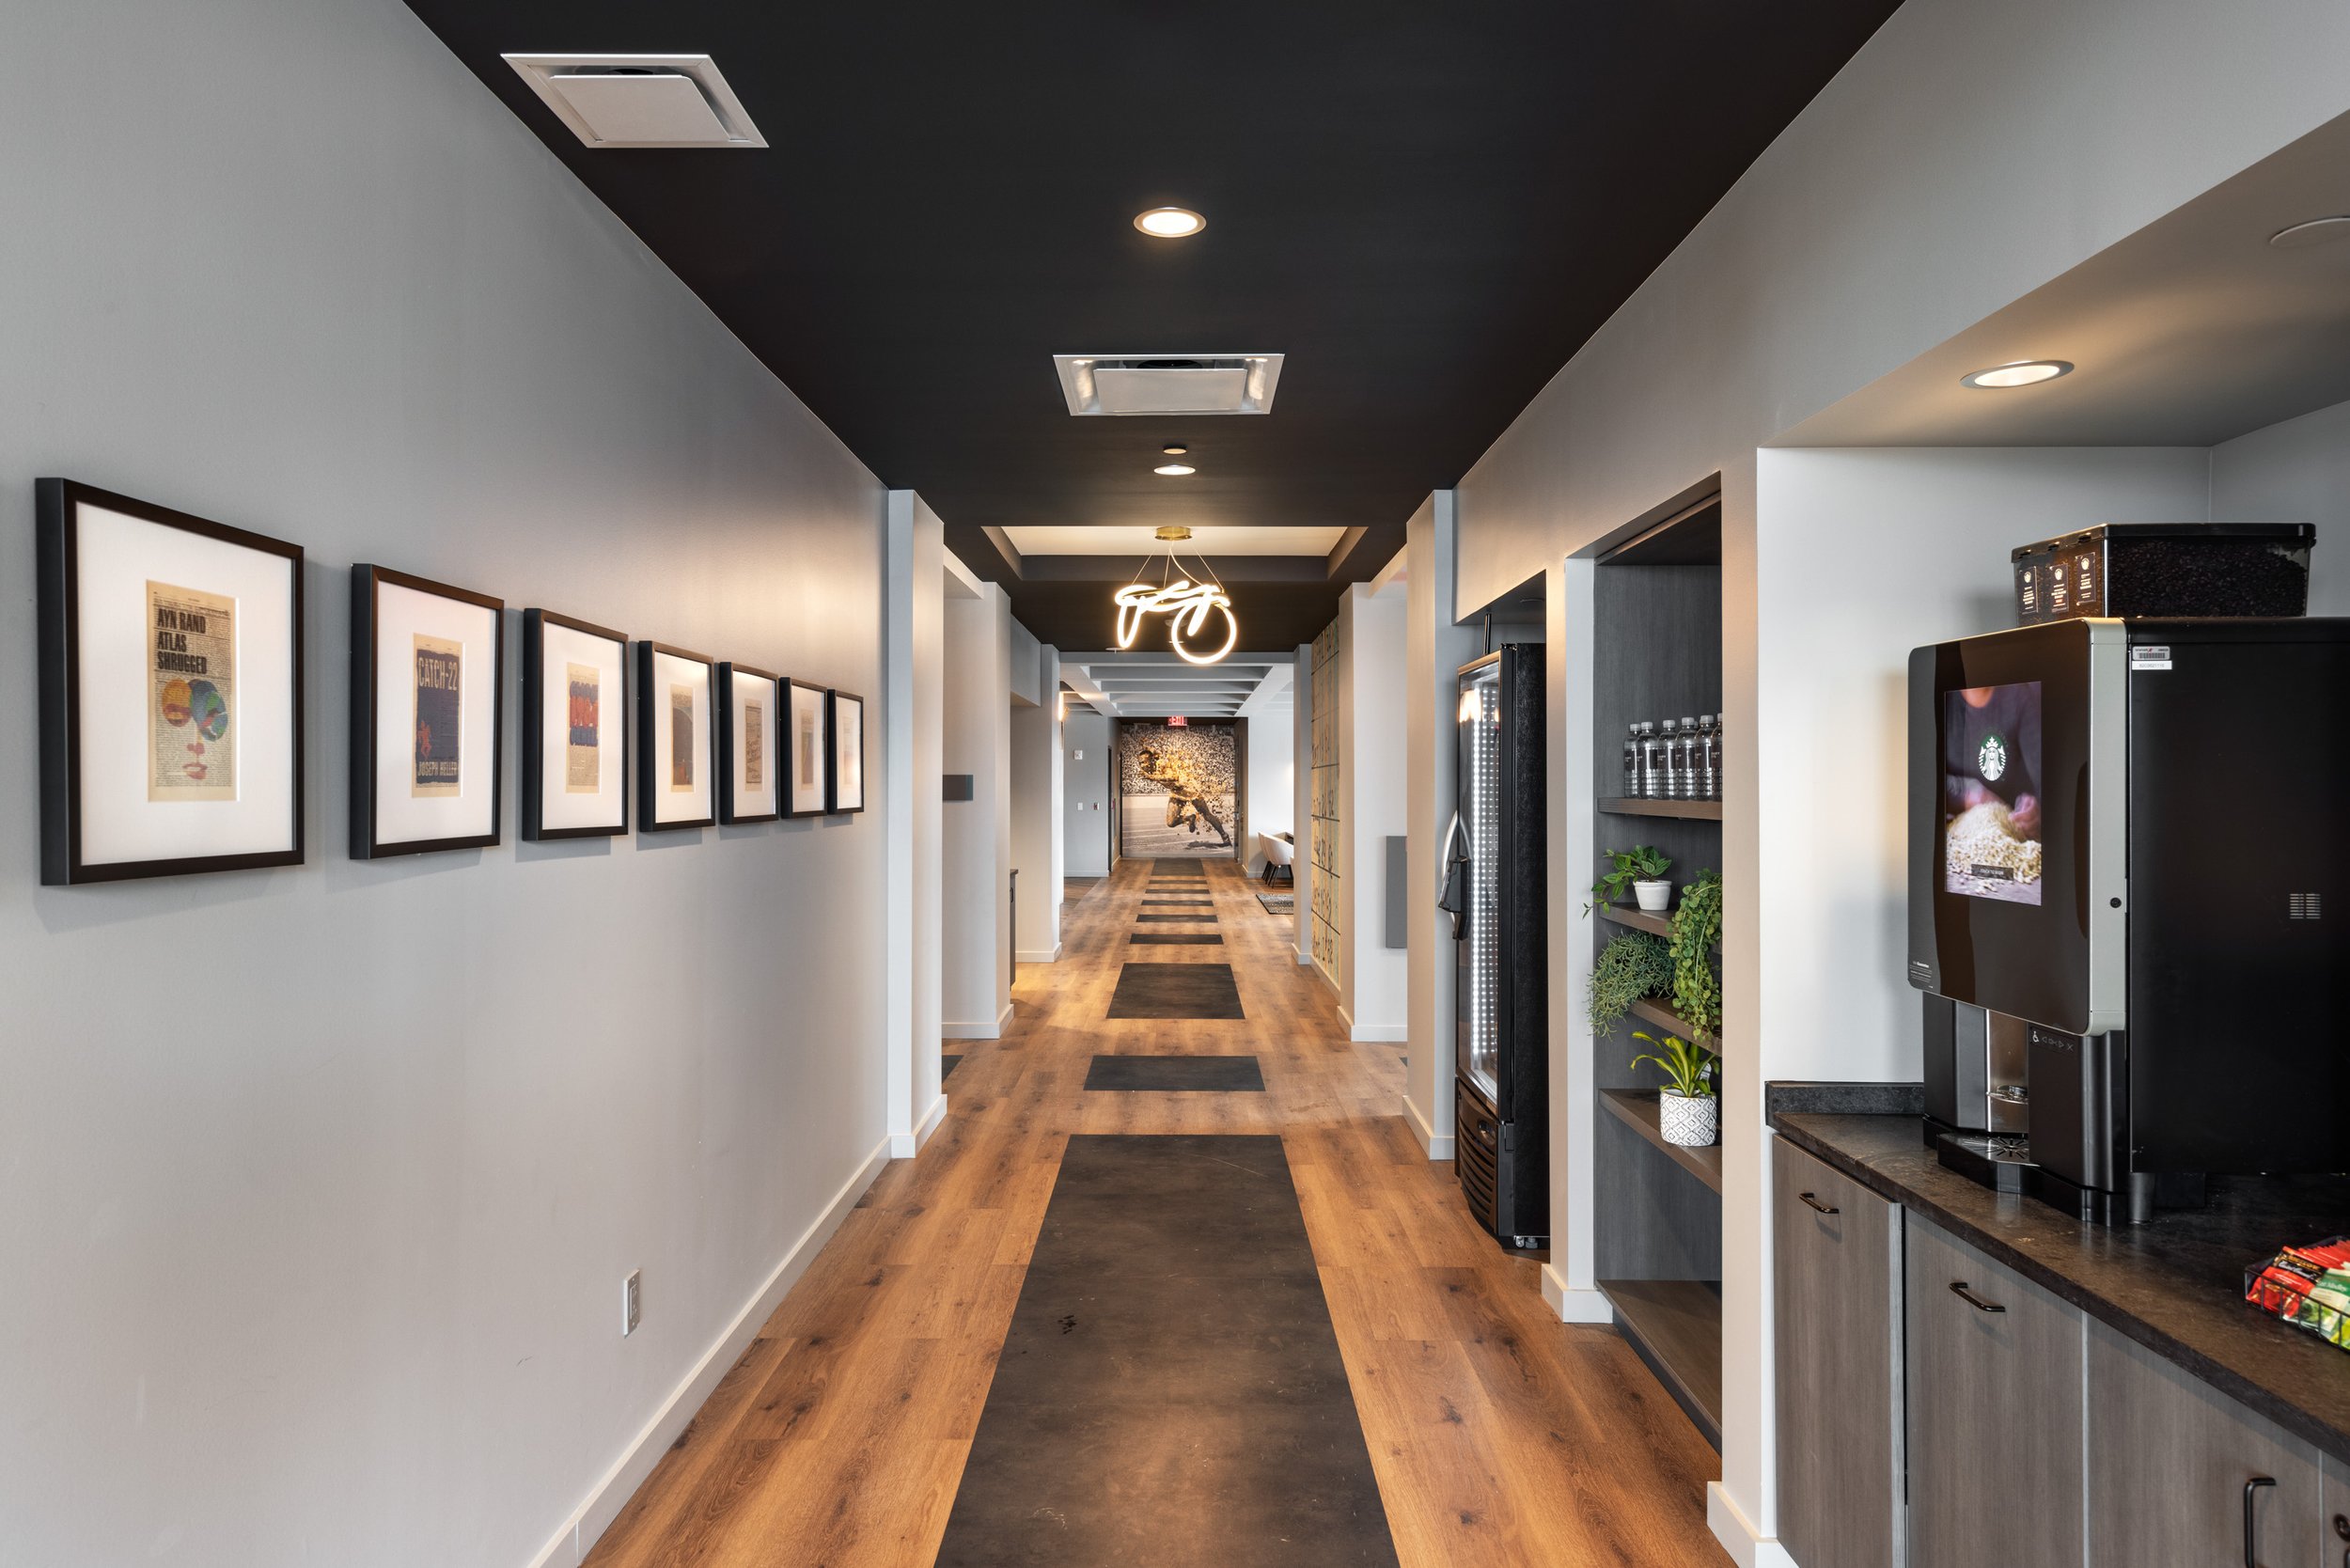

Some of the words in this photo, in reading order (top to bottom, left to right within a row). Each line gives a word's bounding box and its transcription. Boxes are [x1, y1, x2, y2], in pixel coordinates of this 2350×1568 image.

[158, 608, 177, 629] AYN
[180, 612, 206, 634] RAND
[158, 631, 187, 652] ATLAS
[158, 651, 207, 674] SHRUGGED
[418, 656, 458, 691] CATCH-22
